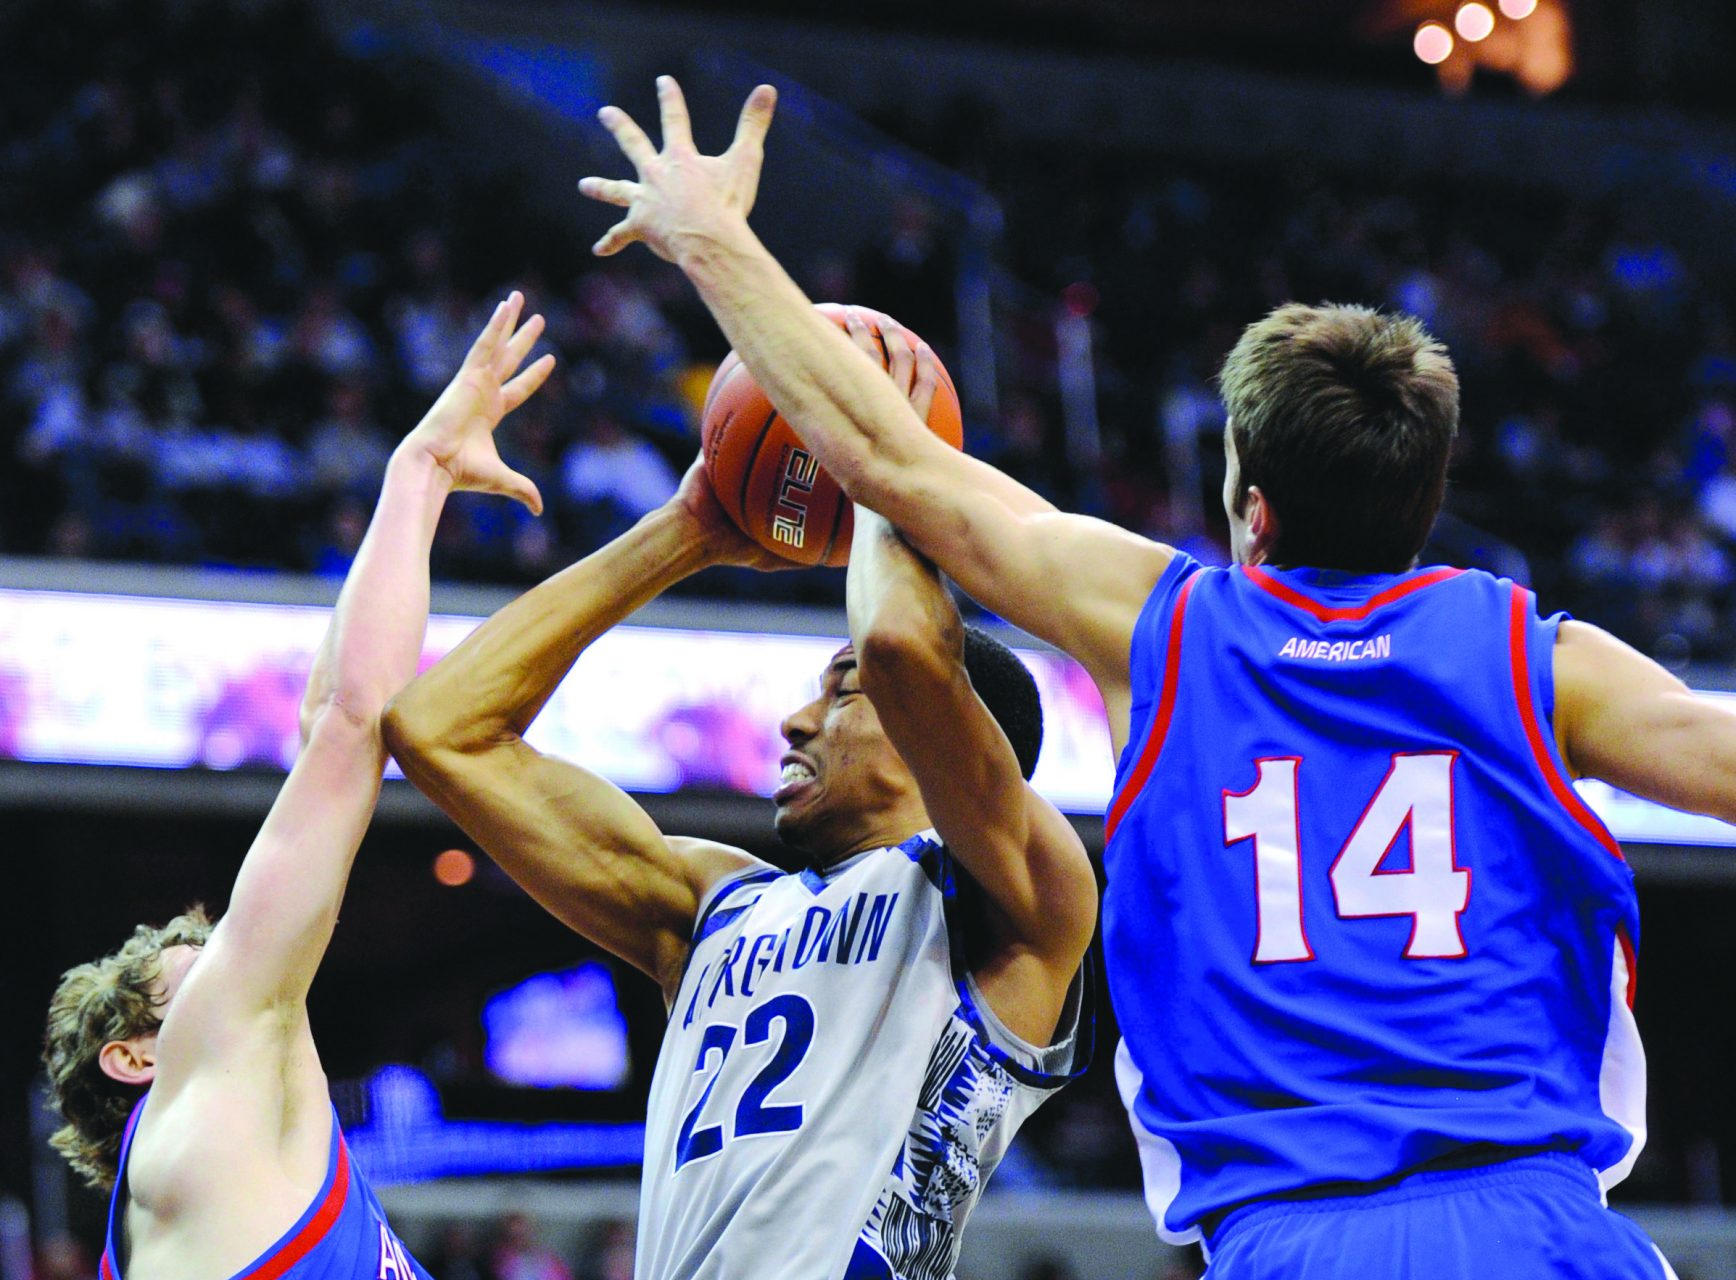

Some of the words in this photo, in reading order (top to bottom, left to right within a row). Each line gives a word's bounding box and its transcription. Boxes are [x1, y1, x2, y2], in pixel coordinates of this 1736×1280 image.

[772, 447, 820, 549] ELITE
[1278, 634, 1392, 662] AMERICAN
[1221, 750, 1472, 966] 14
[673, 992, 818, 1180] 22
